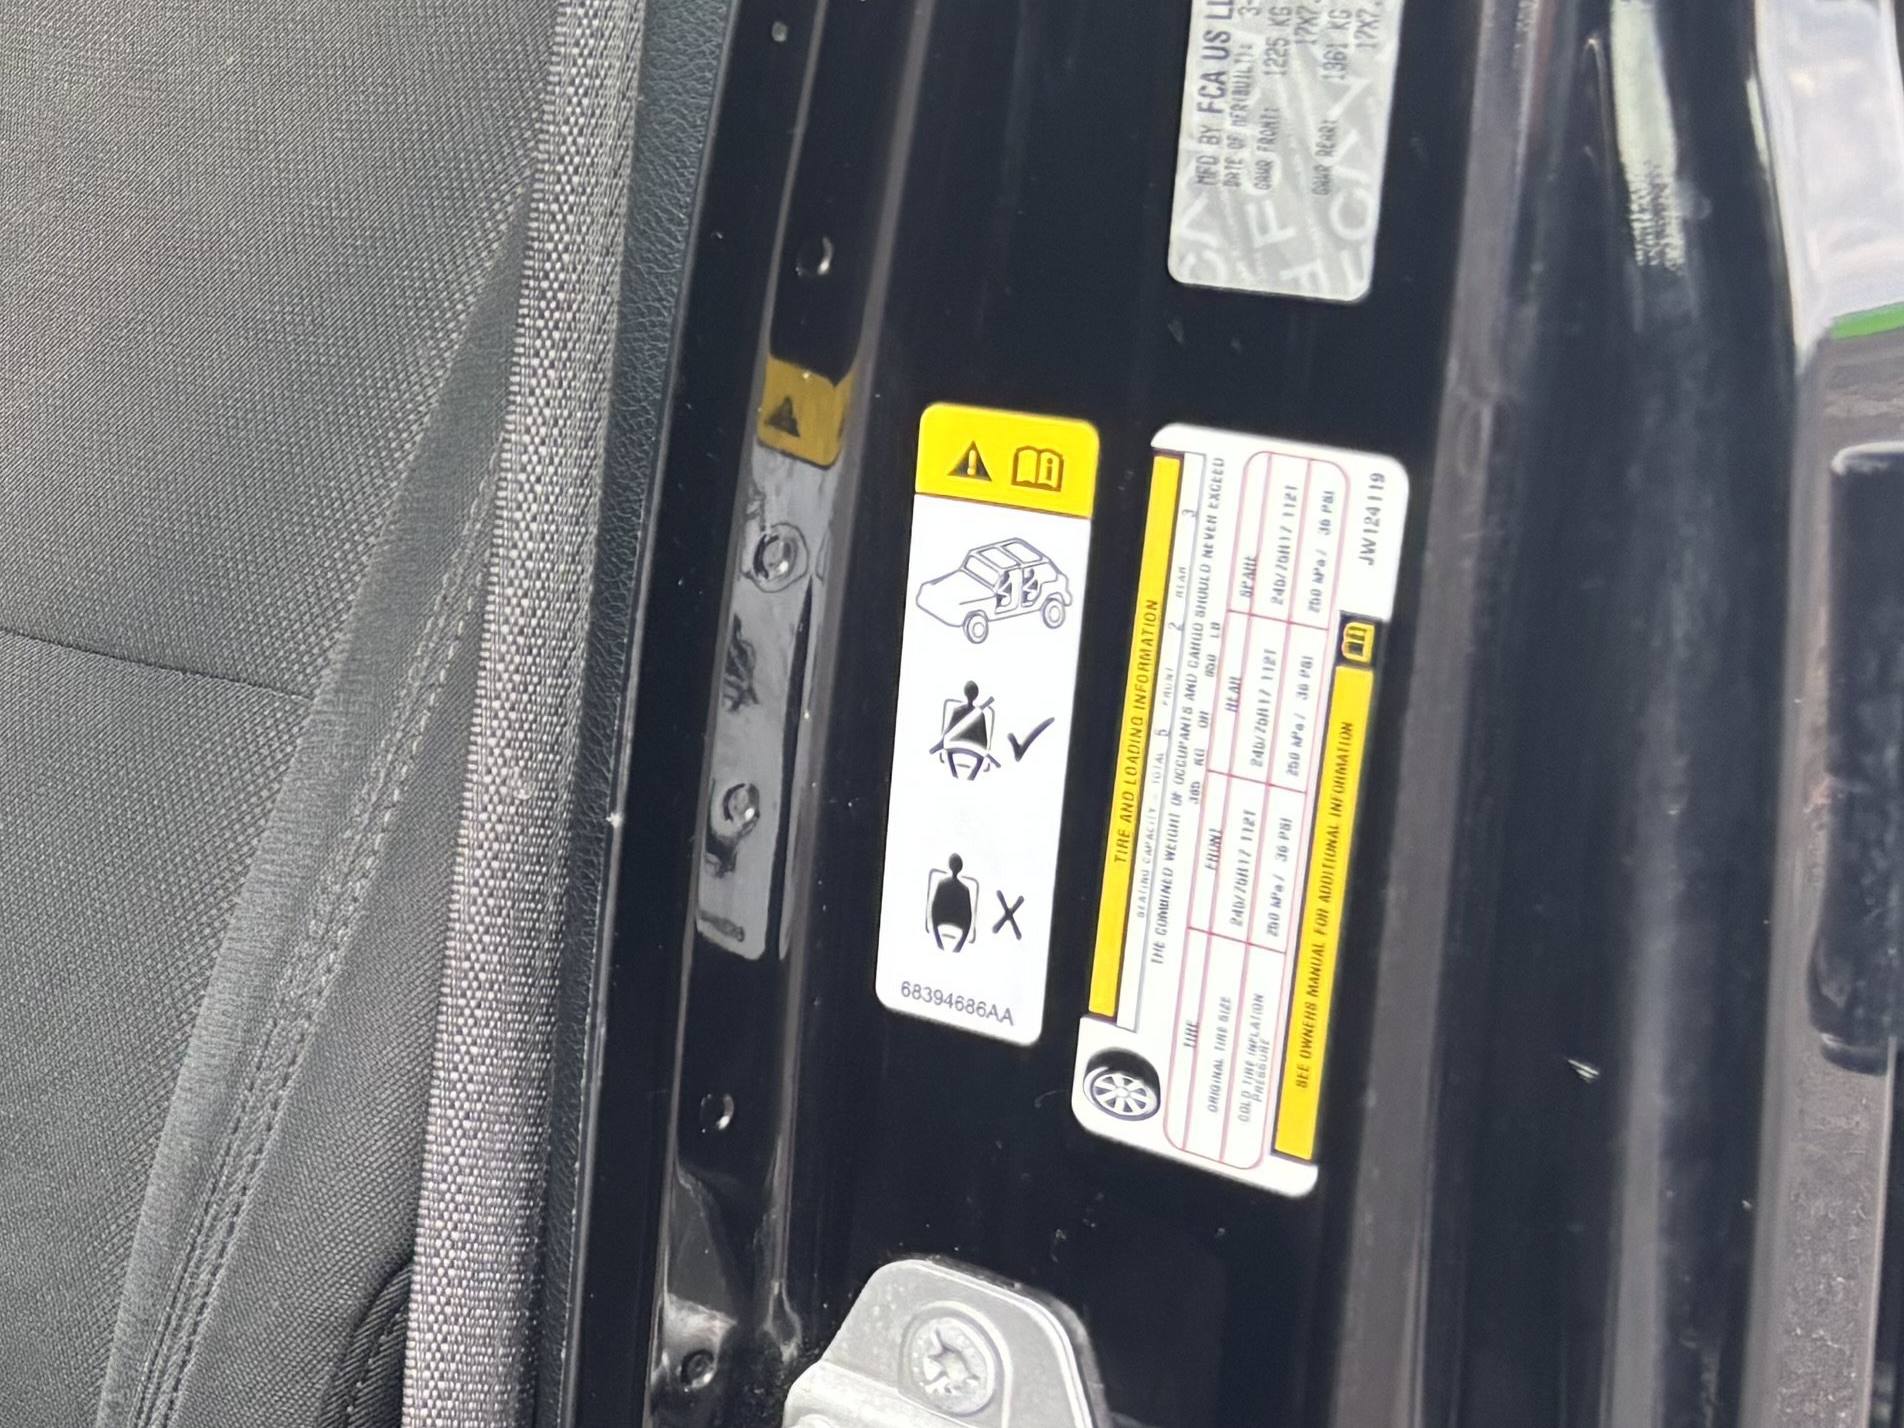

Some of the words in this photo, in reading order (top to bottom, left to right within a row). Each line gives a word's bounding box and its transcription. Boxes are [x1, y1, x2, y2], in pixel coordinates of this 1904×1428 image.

[1262, 35, 1289, 77] 1225
[1321, 39, 1350, 81] 1361
[1196, 69, 1228, 114] FCA
[1193, 154, 1217, 187] MFD
[1223, 156, 1243, 188] DATE
[1206, 456, 1226, 510] EXCEED
[1200, 513, 1218, 559] NEVER
[1357, 471, 1386, 566] JW124119
[1193, 563, 1212, 618] SHOULD
[1238, 552, 1258, 599] SPARE
[1131, 598, 1159, 711] INFORMATION
[1186, 620, 1205, 669] CARGO
[1182, 672, 1198, 701] AND
[1122, 713, 1145, 786] LOADING
[1150, 750, 1165, 785] TOTAL
[1171, 704, 1194, 786] OCCUPANTS
[1327, 719, 1353, 818] INFORMATION
[1118, 789, 1135, 823] AND
[1113, 827, 1130, 865] TIRE
[1162, 811, 1181, 862] WEIGHT
[1203, 825, 1223, 871] FRONT
[1315, 821, 1340, 904] ADDITIONAL
[1152, 865, 1174, 936] COMBINED
[1312, 906, 1329, 936] FOR
[1150, 938, 1166, 965] THE
[1304, 939, 1325, 998] MANUAL
[900, 980, 1014, 1026] 68394686AA
[1244, 991, 1265, 1057] INFLATION
[1182, 1018, 1199, 1050] TIRE
[1213, 1024, 1228, 1053] TIRE
[1297, 999, 1318, 1060] OWNERS
[1205, 1055, 1225, 1114] ORIGINAL
[1241, 1059, 1256, 1086] TIRE
[1251, 1036, 1271, 1103] PRESSURE
[1294, 1062, 1311, 1090] SEE
[1236, 1088, 1254, 1124] COLD
